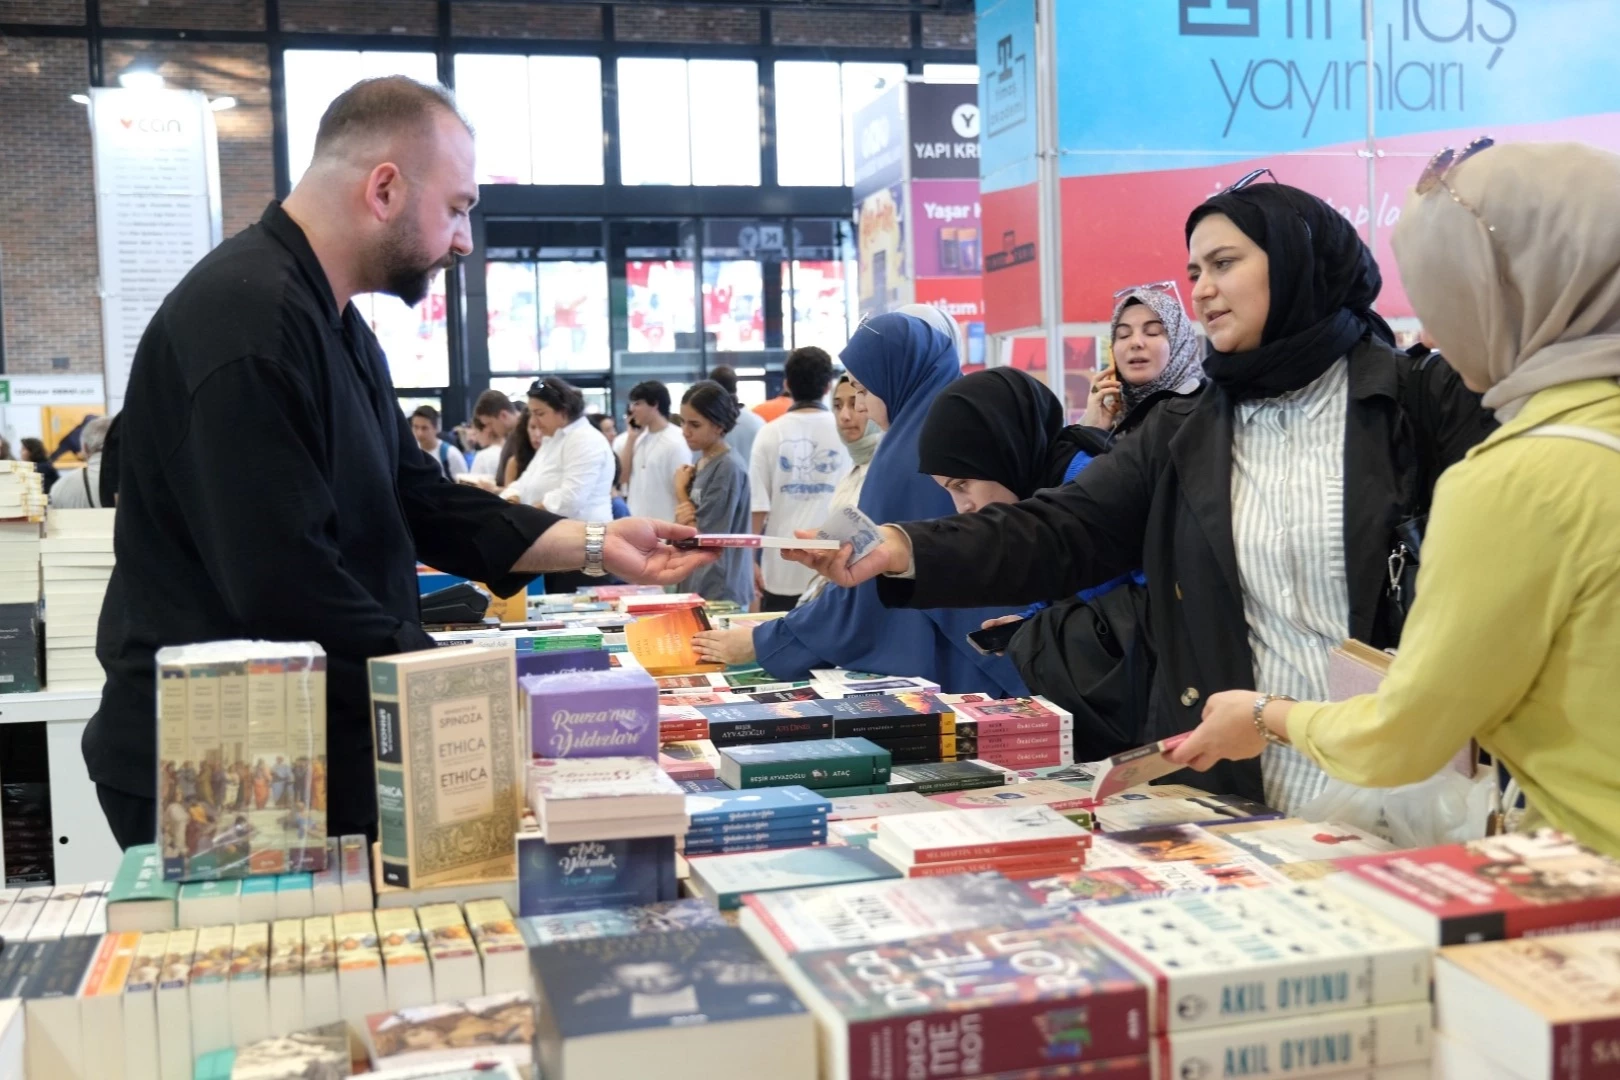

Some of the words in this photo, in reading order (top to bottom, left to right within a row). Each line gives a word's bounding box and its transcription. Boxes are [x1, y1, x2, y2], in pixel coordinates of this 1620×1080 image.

[1210, 23, 1465, 139] yayınları
[138, 118, 181, 133] can
[914, 143, 951, 160] YAPI
[923, 202, 971, 222] Yaşar
[439, 712, 483, 728] SPINOZA
[550, 729, 640, 757] Yıldızları
[722, 728, 766, 739] AYVAZOĞLU
[438, 737, 487, 757] ETHICA
[440, 765, 488, 787] ETHICA
[750, 775, 768, 783] BEŞİR
[769, 772, 807, 781] AYVAZOĞLU
[831, 769, 851, 778] ATAÇ
[1220, 981, 1267, 1014] AKIL
[1278, 971, 1348, 1009] OYUNU
[1223, 1043, 1269, 1078] AKIL
[1280, 1032, 1351, 1071] OYUNU
